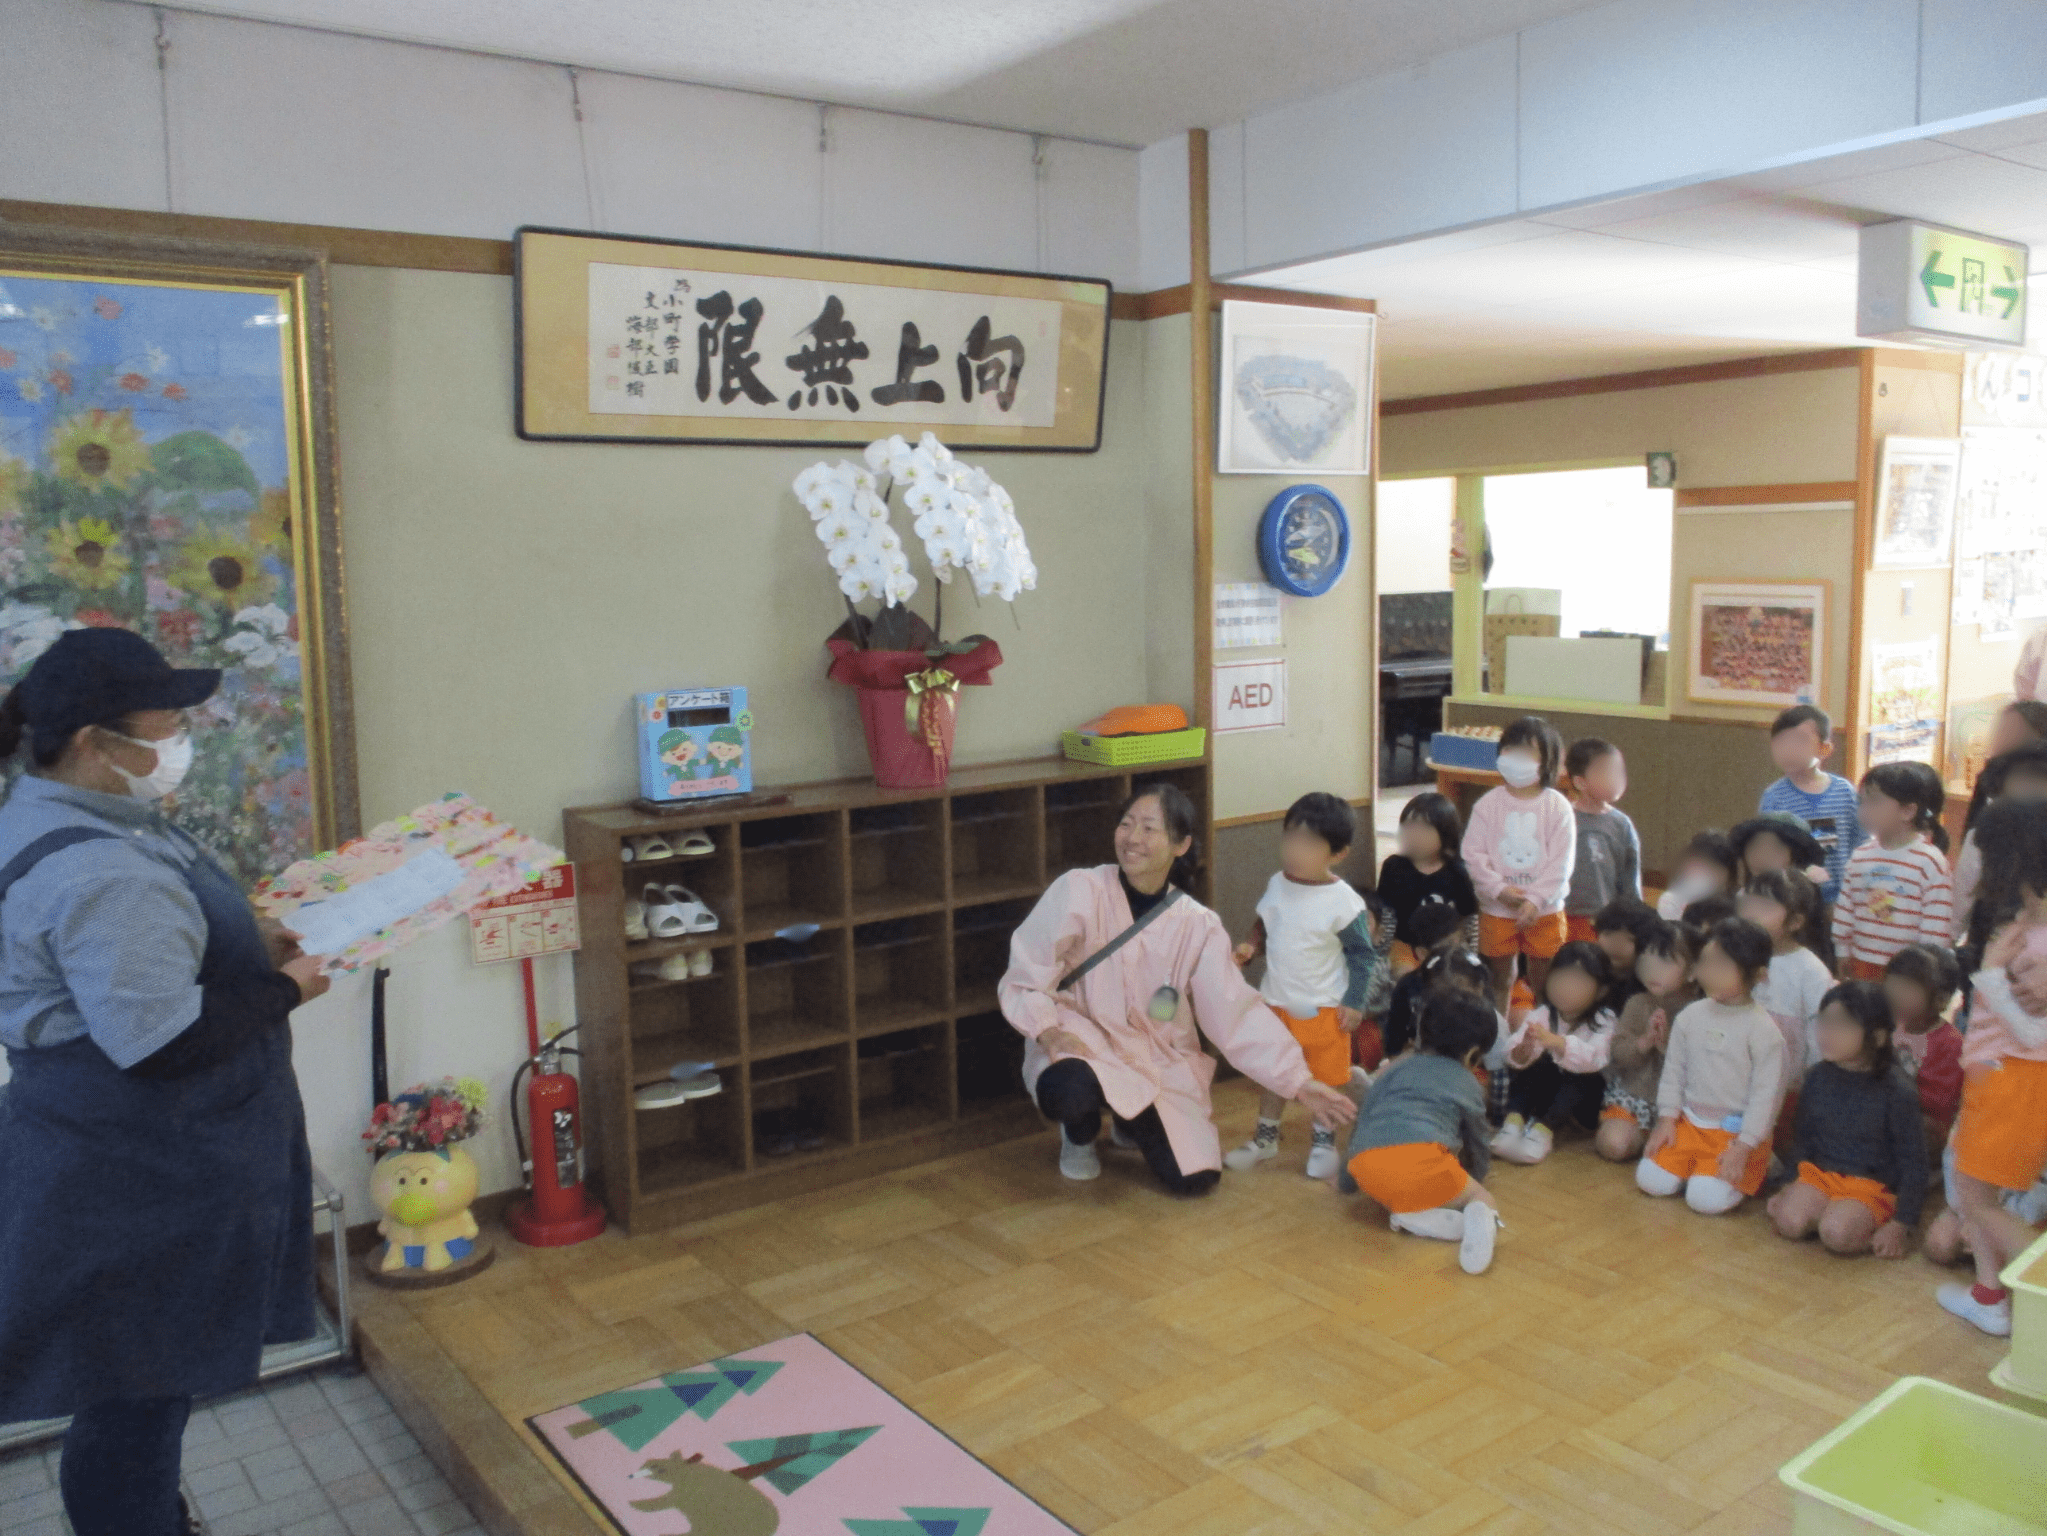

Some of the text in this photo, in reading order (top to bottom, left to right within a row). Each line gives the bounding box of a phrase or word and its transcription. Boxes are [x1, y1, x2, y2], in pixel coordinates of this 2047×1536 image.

[669, 691, 730, 706] アンケート箱
[1228, 682, 1273, 710] AED
